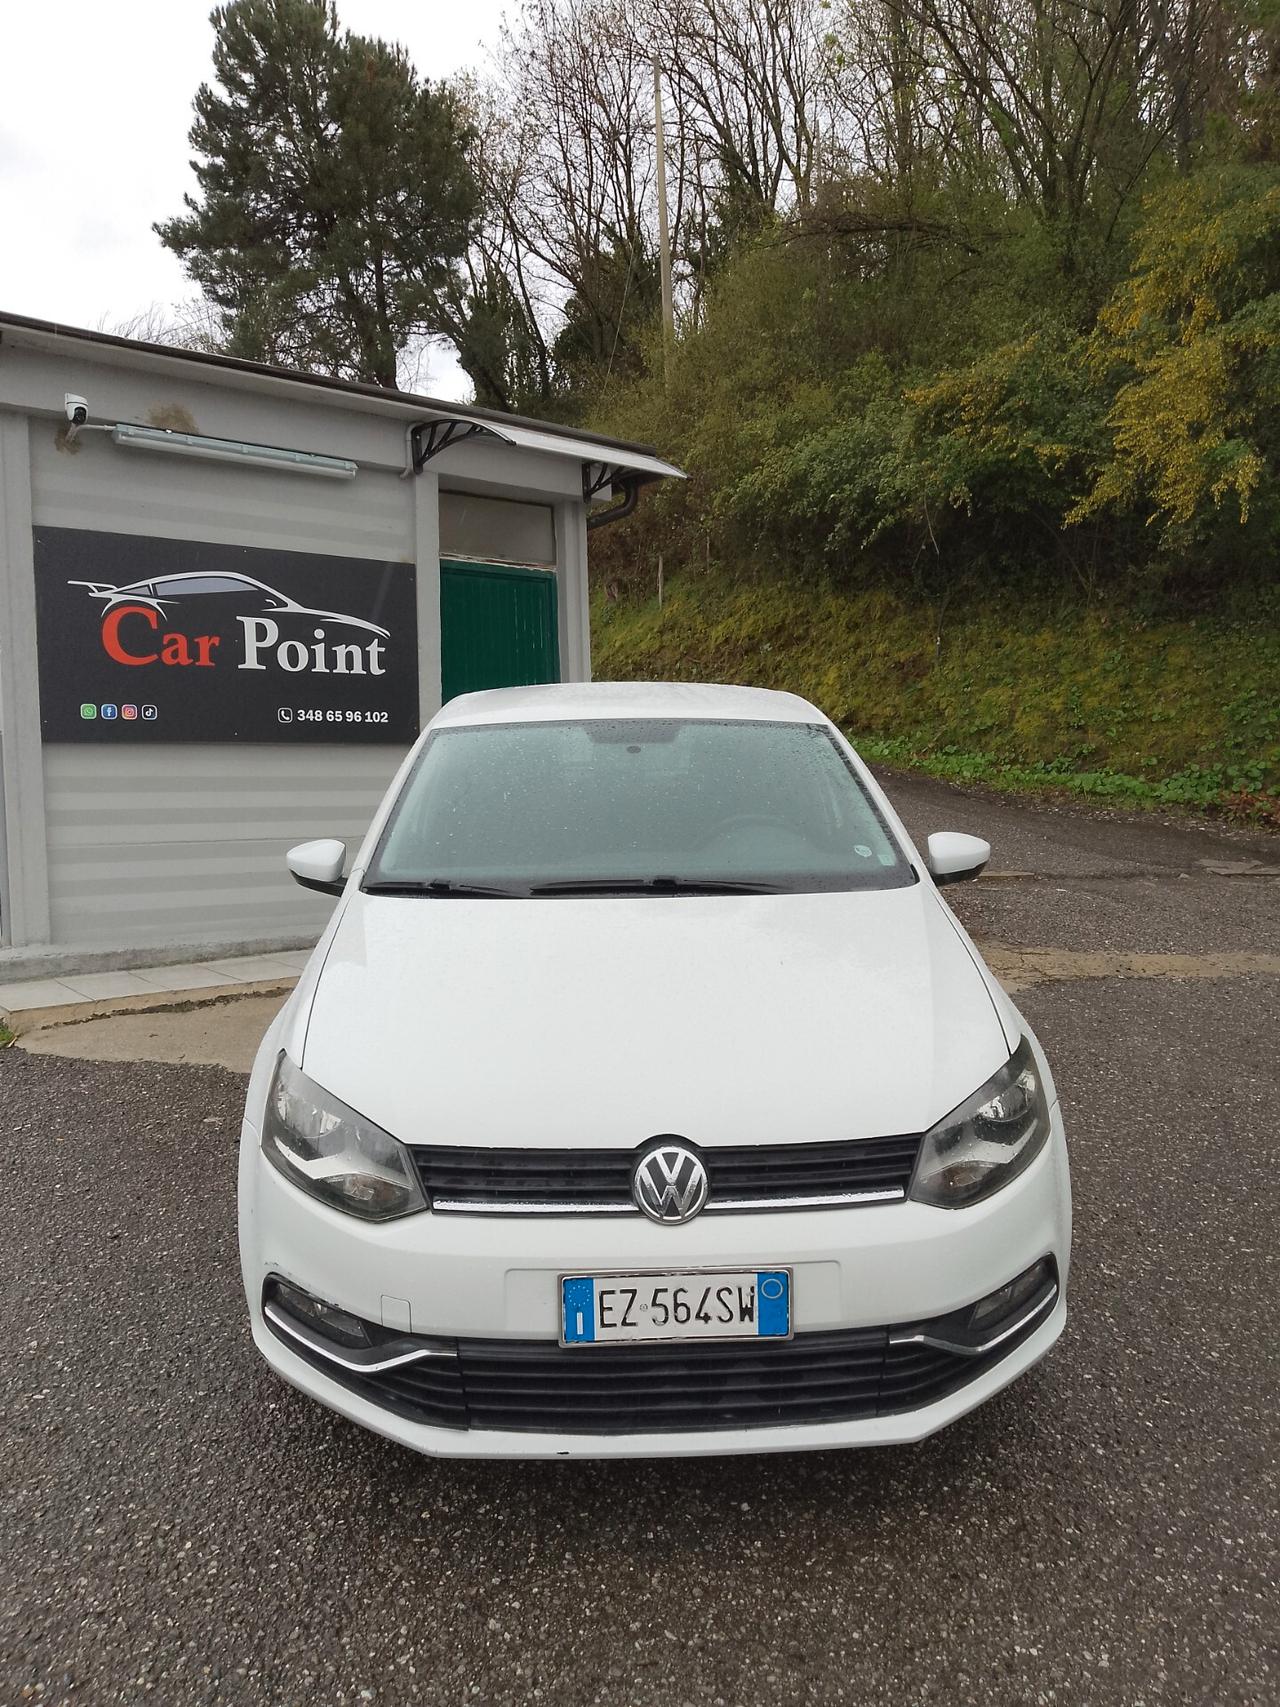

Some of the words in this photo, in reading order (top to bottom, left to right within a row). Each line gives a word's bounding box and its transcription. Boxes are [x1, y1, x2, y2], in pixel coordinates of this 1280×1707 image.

[101, 605, 220, 667] Car
[235, 615, 387, 676] Point
[297, 709, 323, 721] 348
[326, 710, 343, 722] 65
[345, 711, 362, 722] 96
[364, 711, 389, 723] 102
[599, 1288, 638, 1328] EZ
